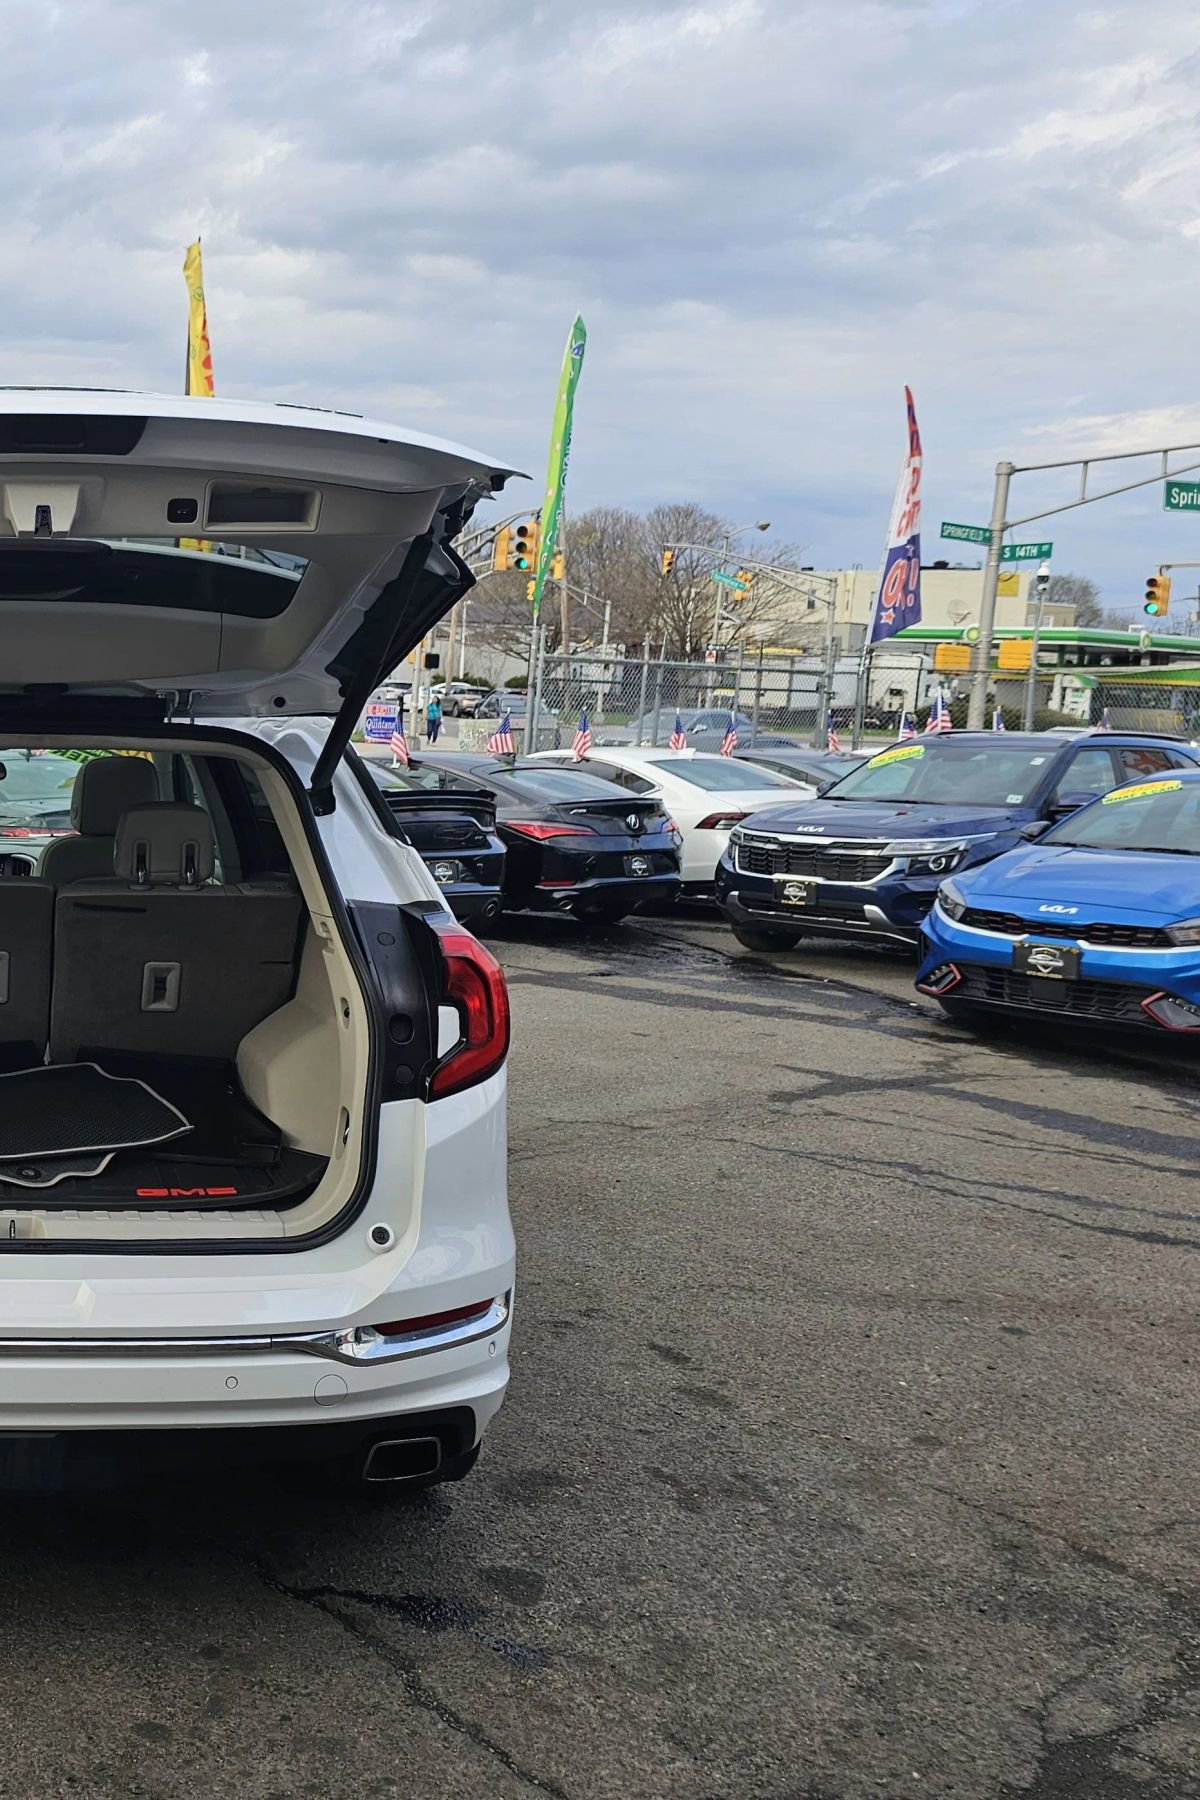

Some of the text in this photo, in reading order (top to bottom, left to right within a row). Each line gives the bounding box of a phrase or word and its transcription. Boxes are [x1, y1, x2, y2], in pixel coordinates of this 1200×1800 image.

[1003, 547, 1010, 558] S
[1015, 545, 1038, 557] 14TH
[136, 1187, 237, 1196] GMC
